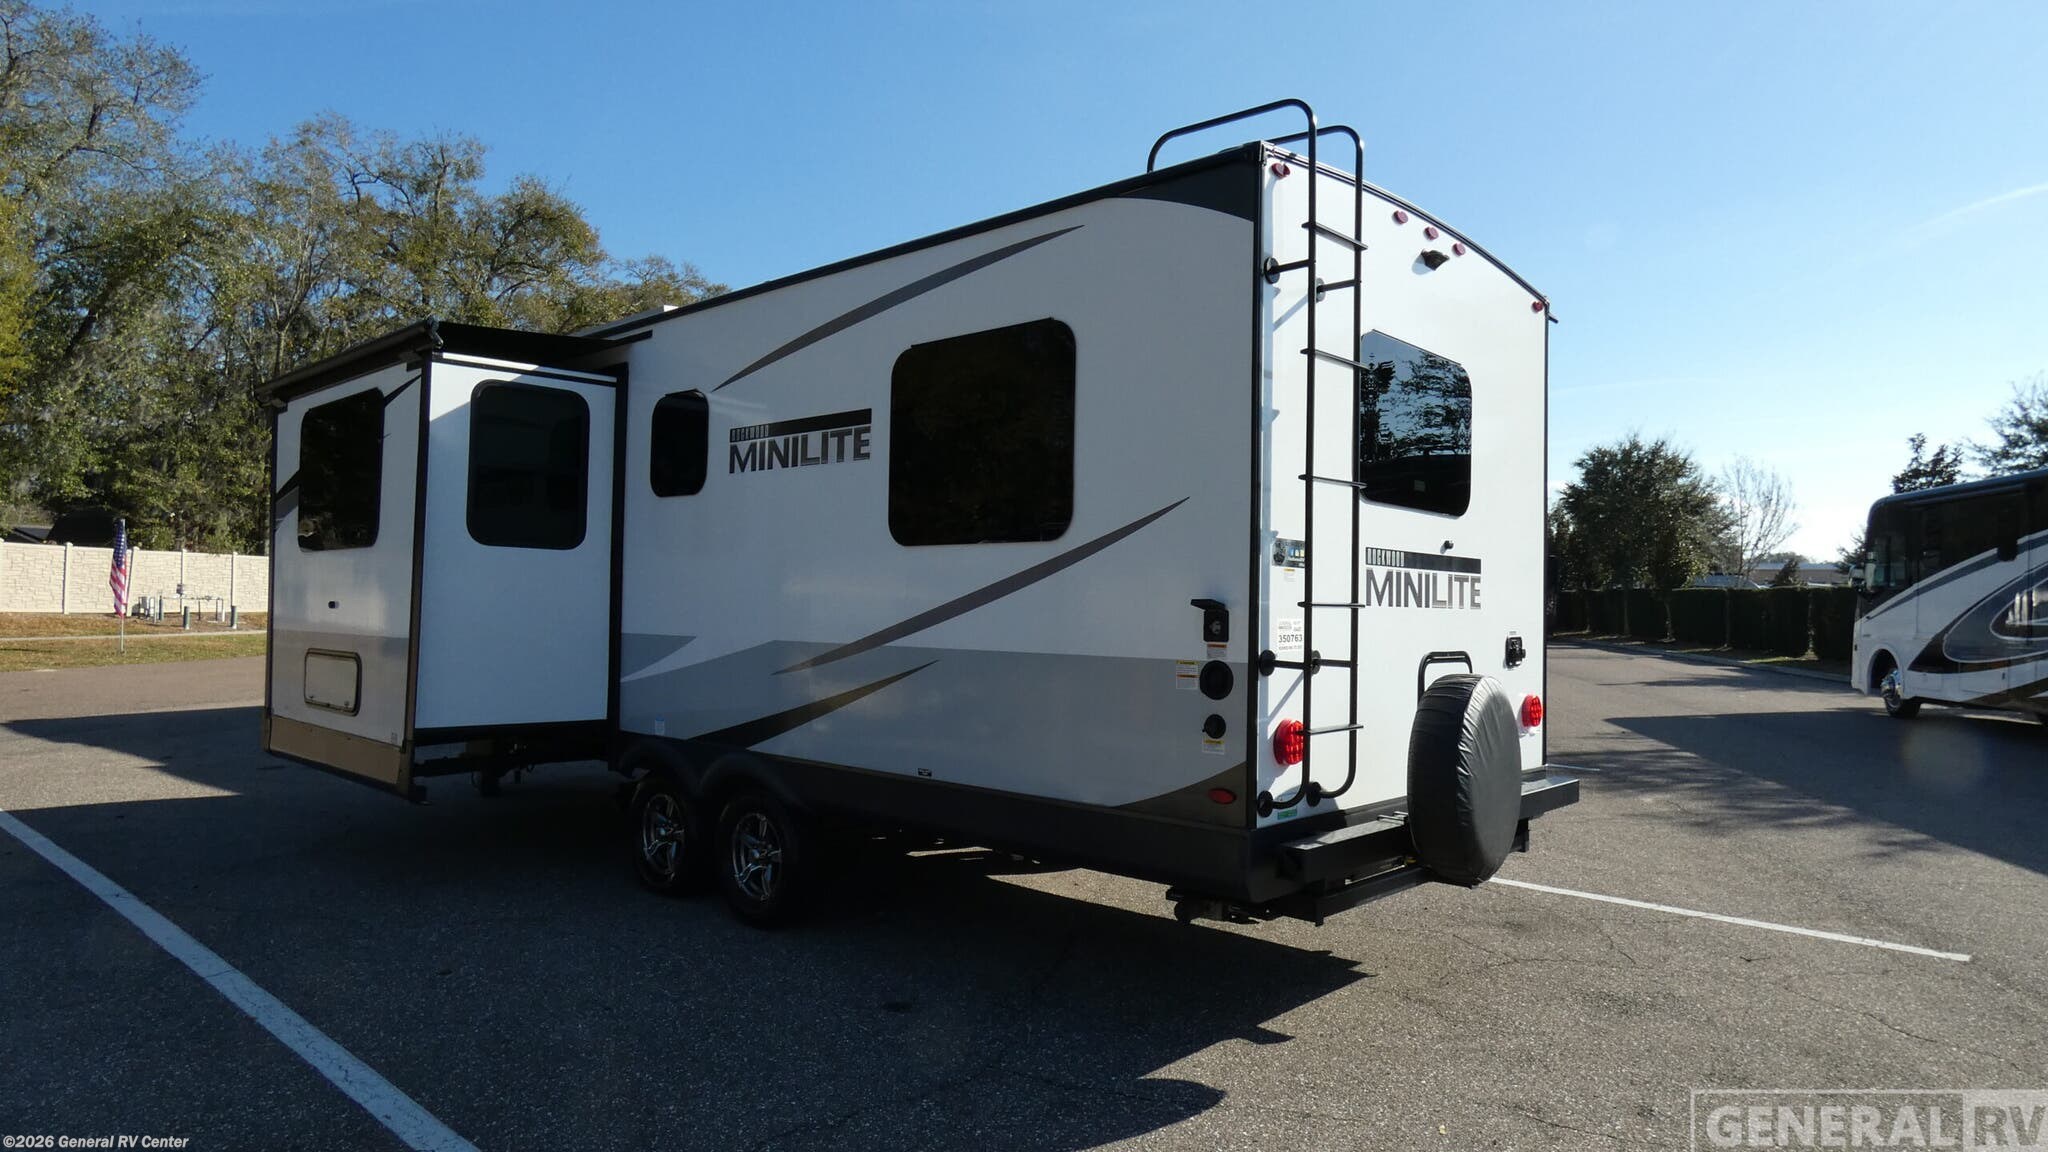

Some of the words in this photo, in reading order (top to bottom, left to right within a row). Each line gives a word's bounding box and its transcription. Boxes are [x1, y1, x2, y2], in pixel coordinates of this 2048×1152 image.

[729, 426, 871, 474] MINILITE
[1365, 568, 1481, 610] MINILITE
[1278, 634, 1303, 643] 350763
